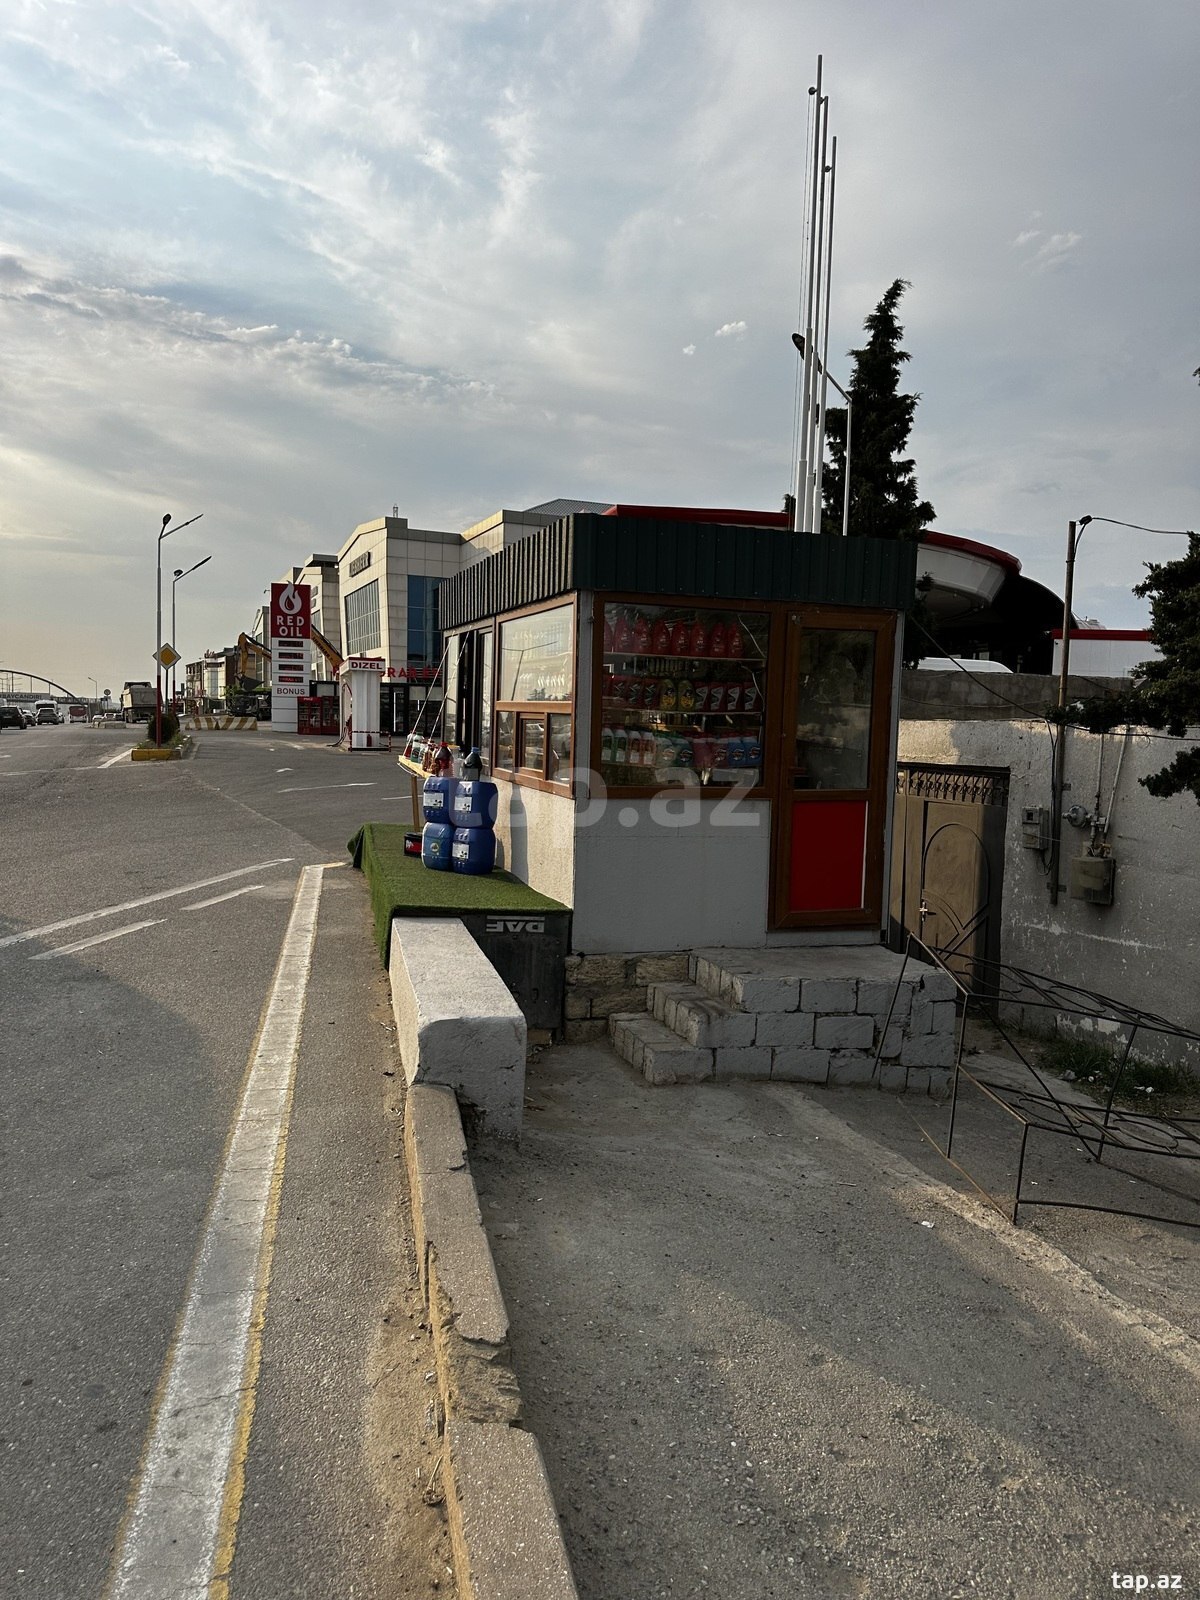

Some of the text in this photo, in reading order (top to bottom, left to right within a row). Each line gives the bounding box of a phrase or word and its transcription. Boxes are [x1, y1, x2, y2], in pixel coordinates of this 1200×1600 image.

[276, 615, 305, 627] RED
[279, 626, 303, 637] OIL
[351, 661, 383, 670] DIZEL
[276, 687, 305, 696] BONUS
[486, 920, 545, 933] DAF
